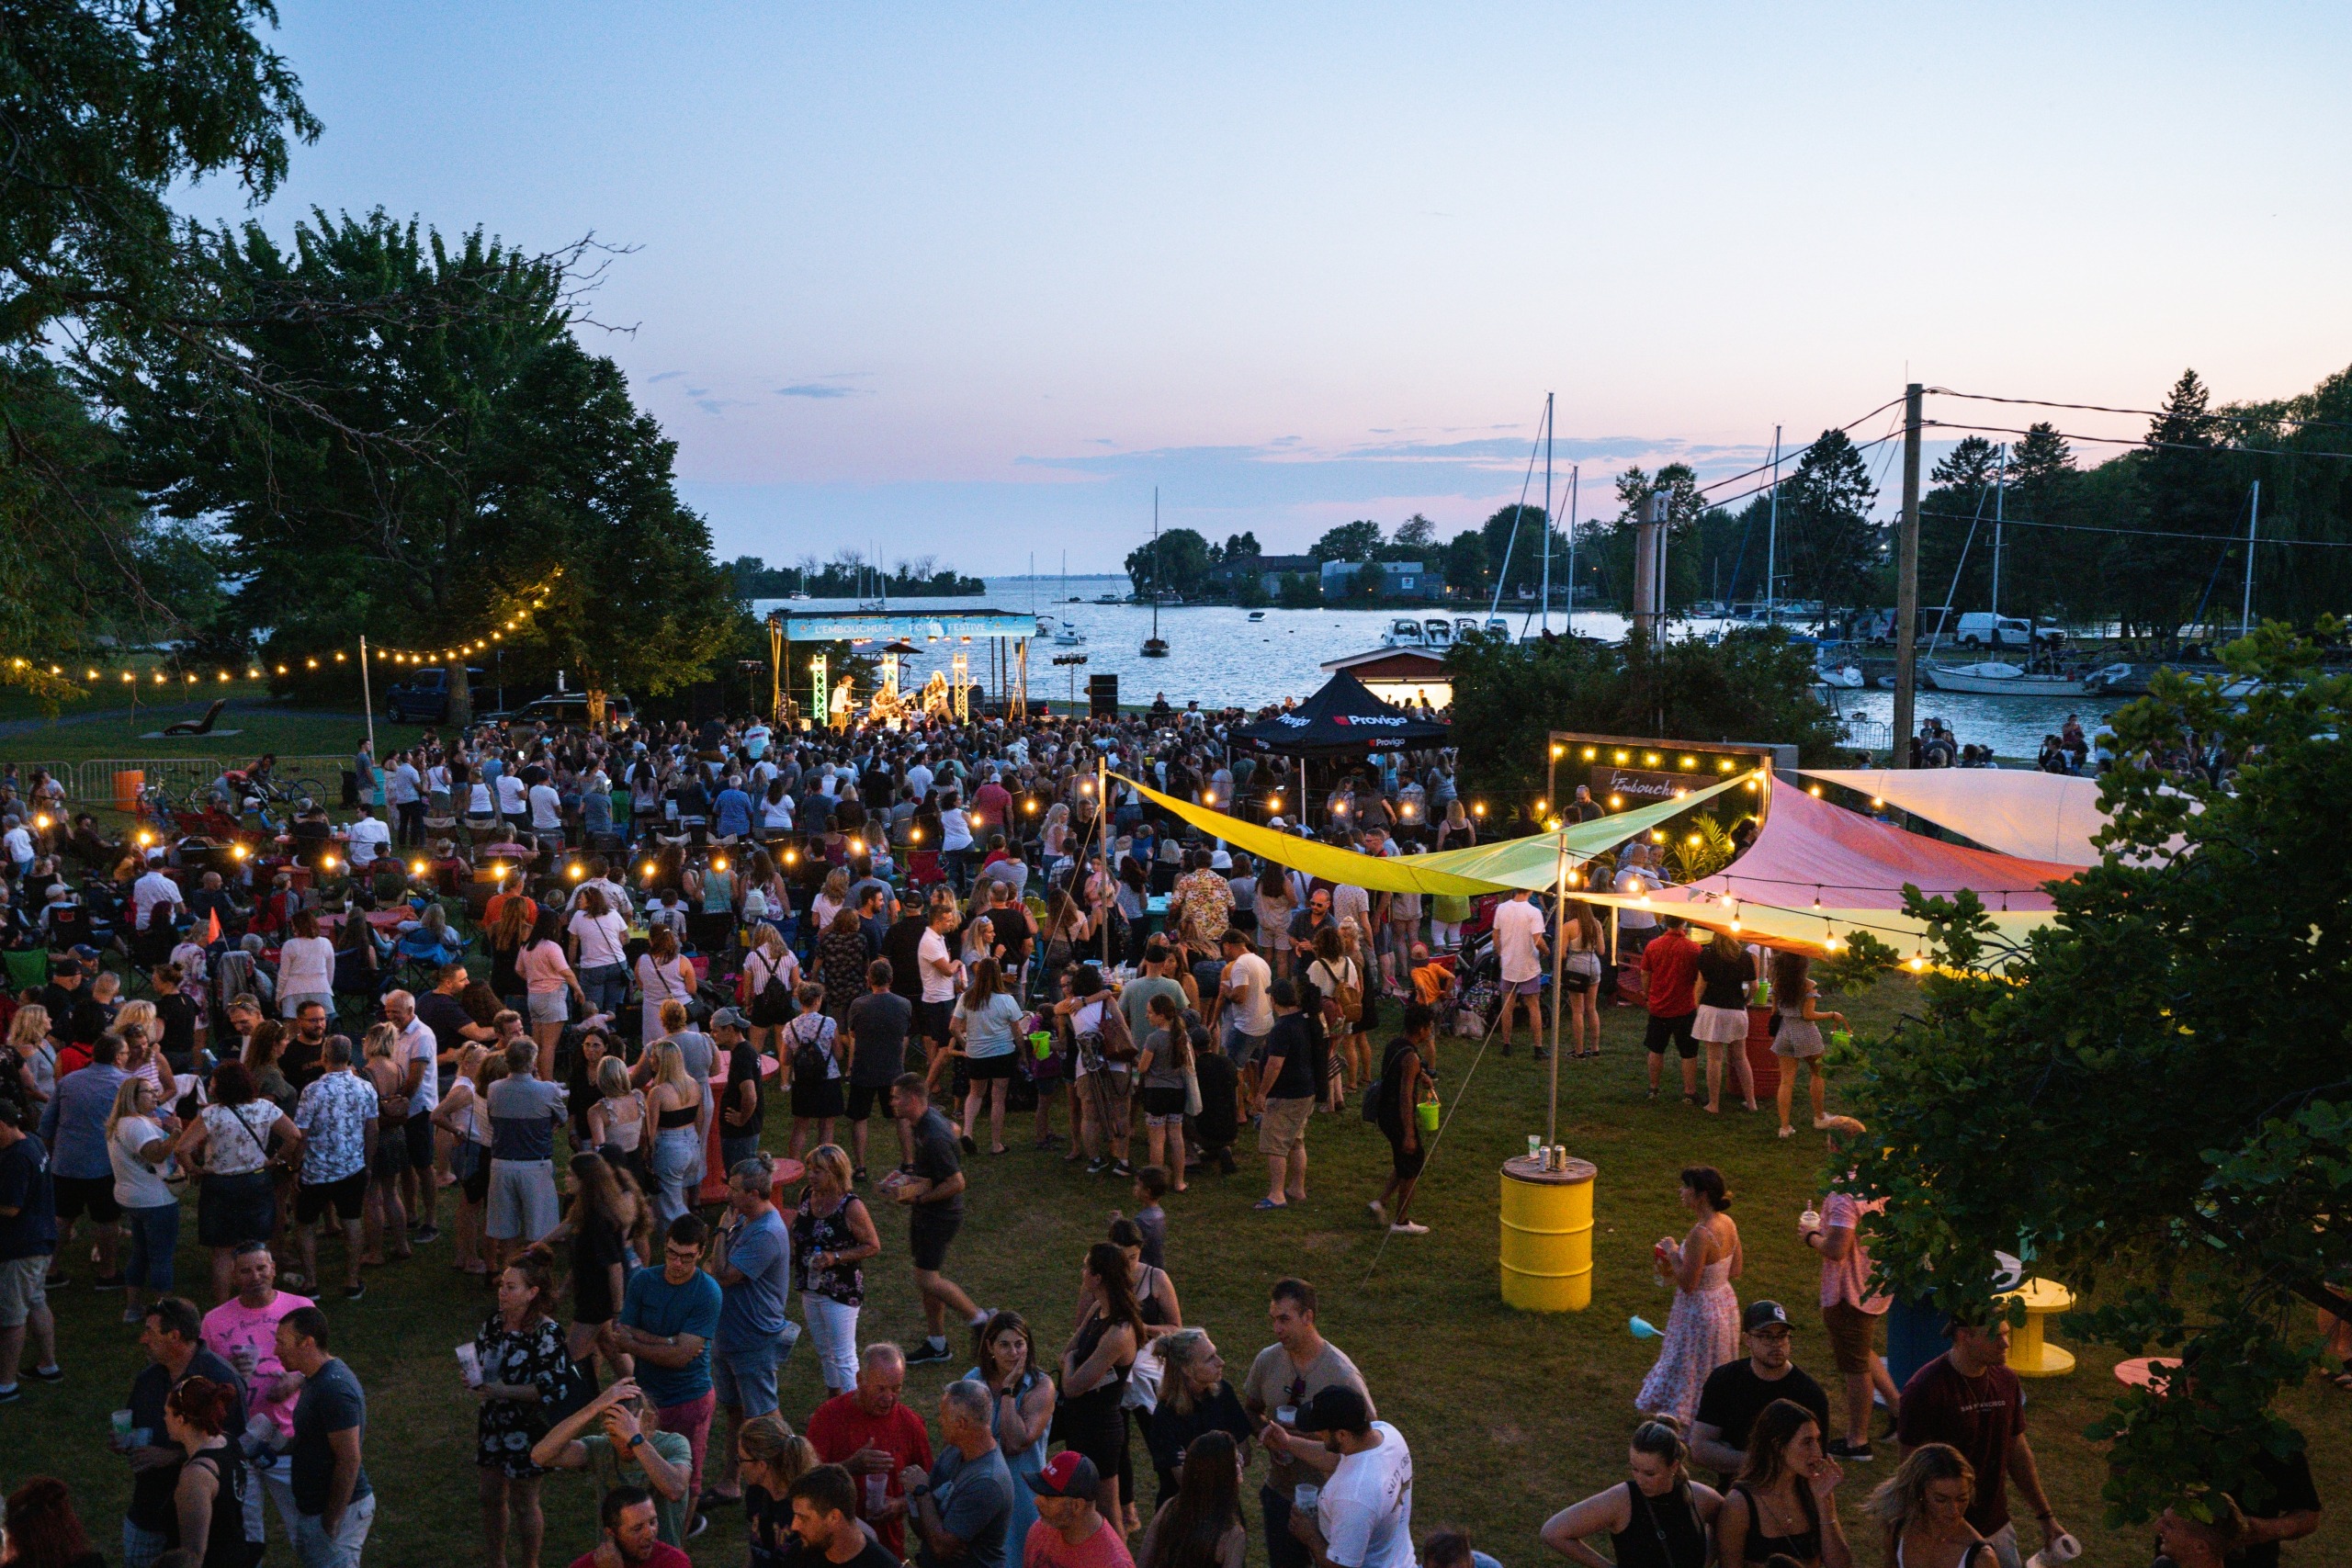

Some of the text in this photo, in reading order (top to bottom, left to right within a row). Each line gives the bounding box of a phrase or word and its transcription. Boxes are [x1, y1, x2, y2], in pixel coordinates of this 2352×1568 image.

[815, 625, 894, 634] L'EMBOUCHURE
[1276, 713, 1311, 728] Provigo
[1348, 715, 1408, 727] Provigo
[1376, 738, 1405, 747] Provigo
[1973, 1400, 2006, 1409] FANCISCO
